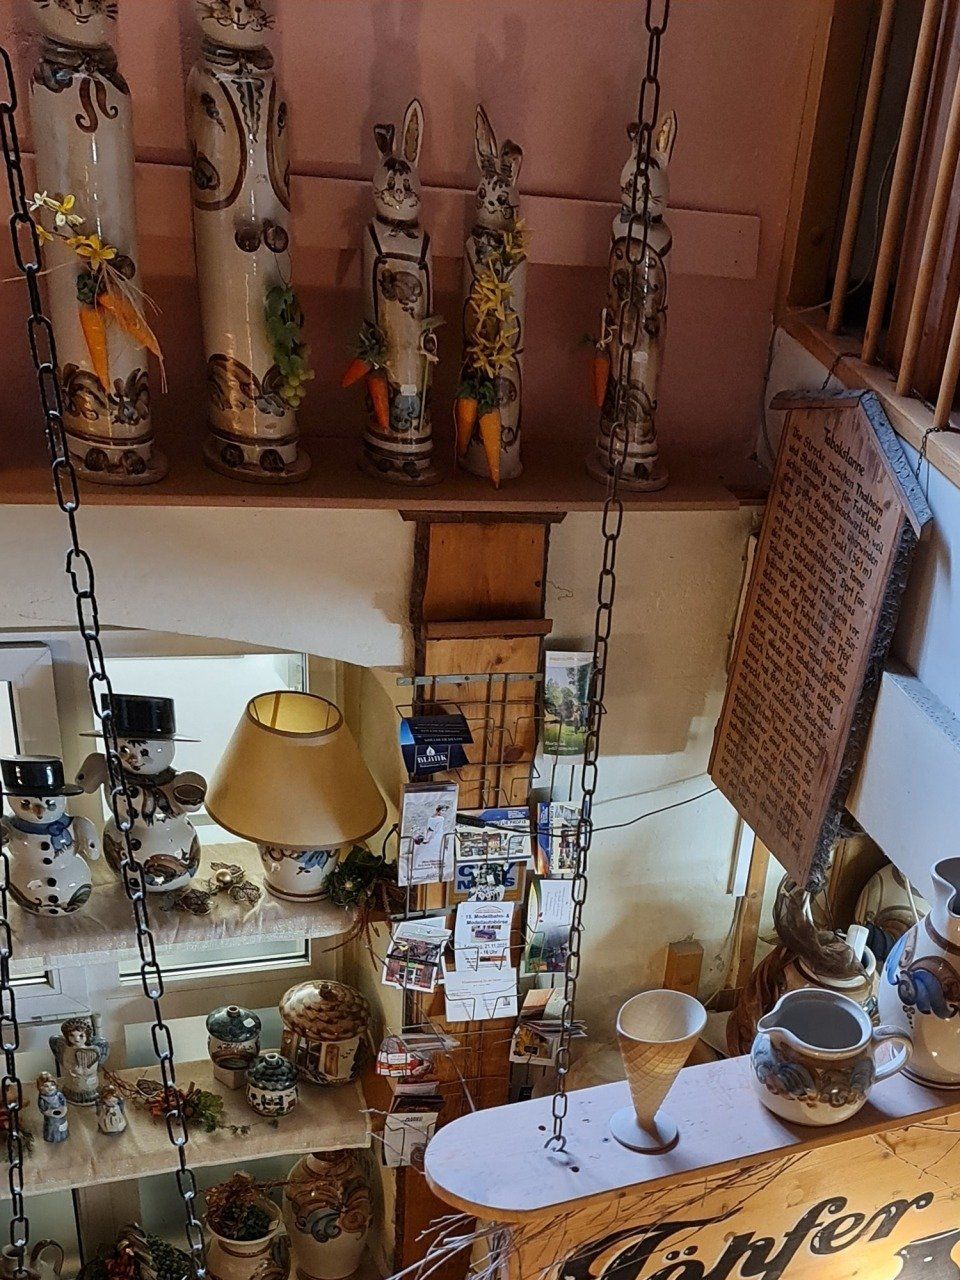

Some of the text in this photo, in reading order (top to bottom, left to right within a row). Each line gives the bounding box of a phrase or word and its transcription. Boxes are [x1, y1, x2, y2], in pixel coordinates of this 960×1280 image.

[791, 426, 884, 517] Die Strecke zwischen Thalheim
[822, 427, 866, 476] Tabakstanne
[798, 450, 828, 487] Stollberg
[828, 480, 840, 496] war
[840, 489, 851, 508] für
[851, 498, 882, 533] Fuhrleute
[803, 470, 820, 493] immer
[871, 536, 884, 555] weil
[784, 522, 798, 542] einer
[839, 577, 854, 597] Dort
[794, 514, 803, 528] bis
[816, 537, 828, 554] eine
[828, 548, 849, 578] riesige
[848, 567, 865, 591] Tanne
[812, 497, 837, 529] Steigung
[837, 524, 845, 536] zu
[846, 530, 879, 567] überwinden
[830, 532, 847, 554] Punkt
[791, 544, 817, 578] Fuhrleute
[818, 570, 837, 596] immer
[836, 592, 855, 617] etwas
[807, 578, 818, 595] und
[817, 588, 848, 628] Feuerstein
[781, 603, 792, 620] und
[836, 660, 848, 678] der
[799, 604, 826, 639] Fuhrleute
[826, 632, 837, 650] ein
[804, 676, 815, 694] Das
[816, 689, 834, 714] sollte
[457, 877, 515, 890] NS
[458, 861, 517, 878] CY
